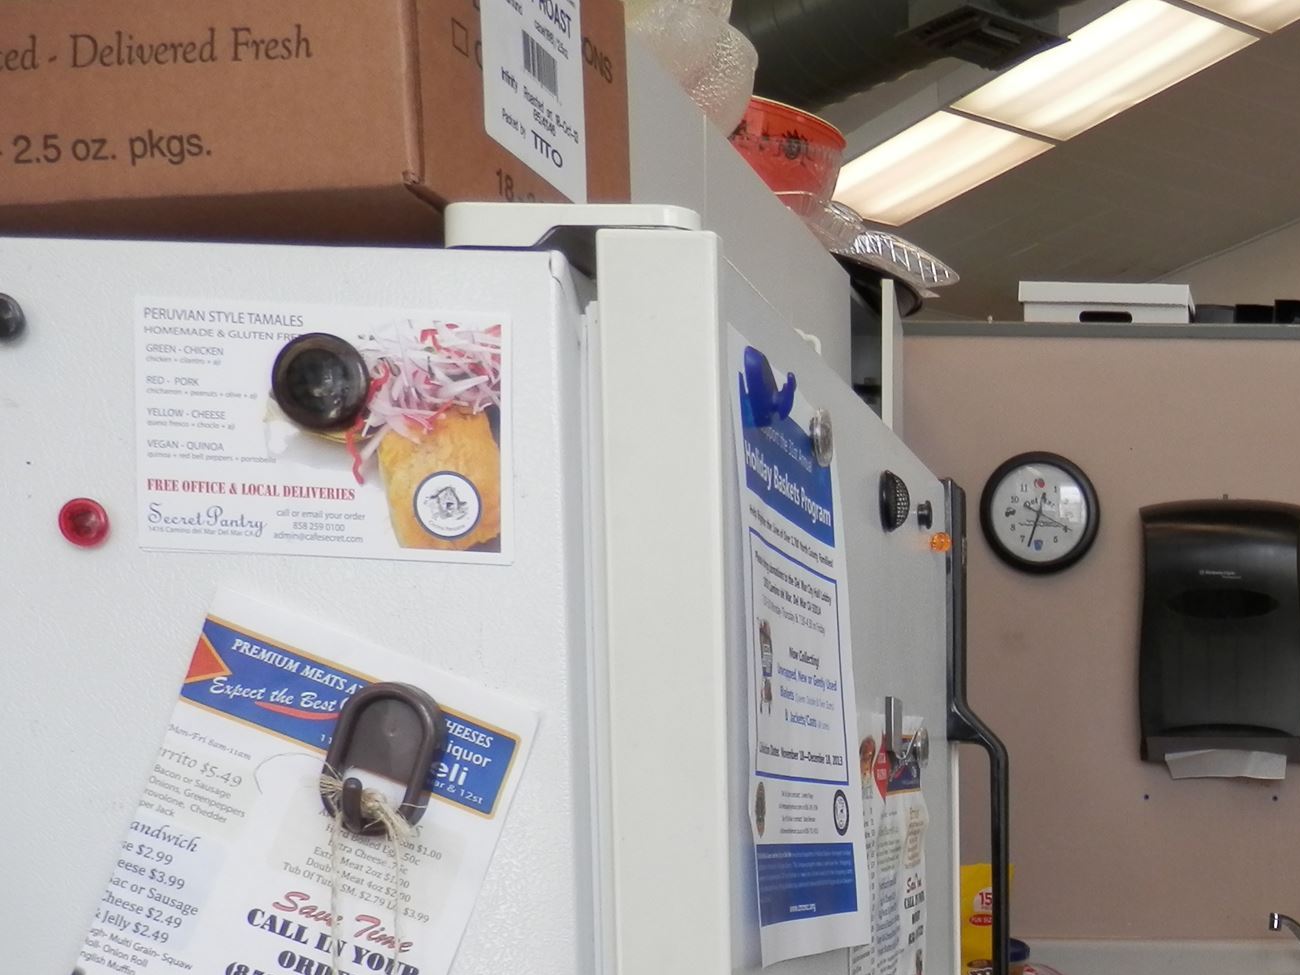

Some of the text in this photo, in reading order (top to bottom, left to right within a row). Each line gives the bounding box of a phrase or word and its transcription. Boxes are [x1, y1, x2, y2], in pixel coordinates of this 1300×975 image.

[69, 27, 217, 69] Delivered
[230, 24, 313, 62] Fresh
[12, 129, 212, 167] 2.5 oz. pkgs.
[531, 129, 563, 169] TITO
[143, 307, 303, 327] PERUVIAN STYLE TAMALES
[143, 326, 273, 340] HOMEMADE & GLUTEN
[146, 344, 224, 356] GREEN CHICKEN
[146, 375, 199, 387] RED PORK
[147, 408, 226, 420] YELLOW CHEESE
[147, 439, 225, 451] VEGAN QUINOA
[147, 478, 356, 501] FREE OFFICE & LOCAL DELIVERIES
[745, 440, 772, 491] Holiday
[773, 464, 801, 506] Baskets
[800, 487, 831, 527] Program
[147, 502, 268, 538] Secret Pantry
[276, 509, 289, 517] call
[301, 510, 323, 519] email
[324, 512, 342, 521] your
[344, 512, 365, 521] order
[293, 522, 309, 531] 858
[210, 677, 337, 712] Expect the Best
[231, 638, 301, 673] PREMIUM
[300, 664, 347, 691] MEATS
[445, 719, 494, 748] HEESES
[159, 747, 242, 787] rrito $5.49
[446, 740, 492, 768] iquor
[153, 764, 182, 781] Bacon
[194, 779, 231, 800] Sausage
[436, 762, 469, 786] eli
[130, 820, 201, 852] andwich
[136, 844, 173, 866] $2.99
[117, 859, 185, 890] eese $3.99
[130, 883, 199, 916] or Sausage
[283, 862, 301, 876] Tub
[403, 907, 430, 923] $3.99
[102, 910, 169, 943] Jelly $2.49
[145, 907, 182, 929] $2.49
[247, 908, 310, 945] CALL
[314, 932, 348, 957] IN
[354, 914, 414, 954] Time
[79, 950, 106, 966] nglish
[102, 944, 149, 968] Onion Roll
[161, 952, 193, 971] Squaw
